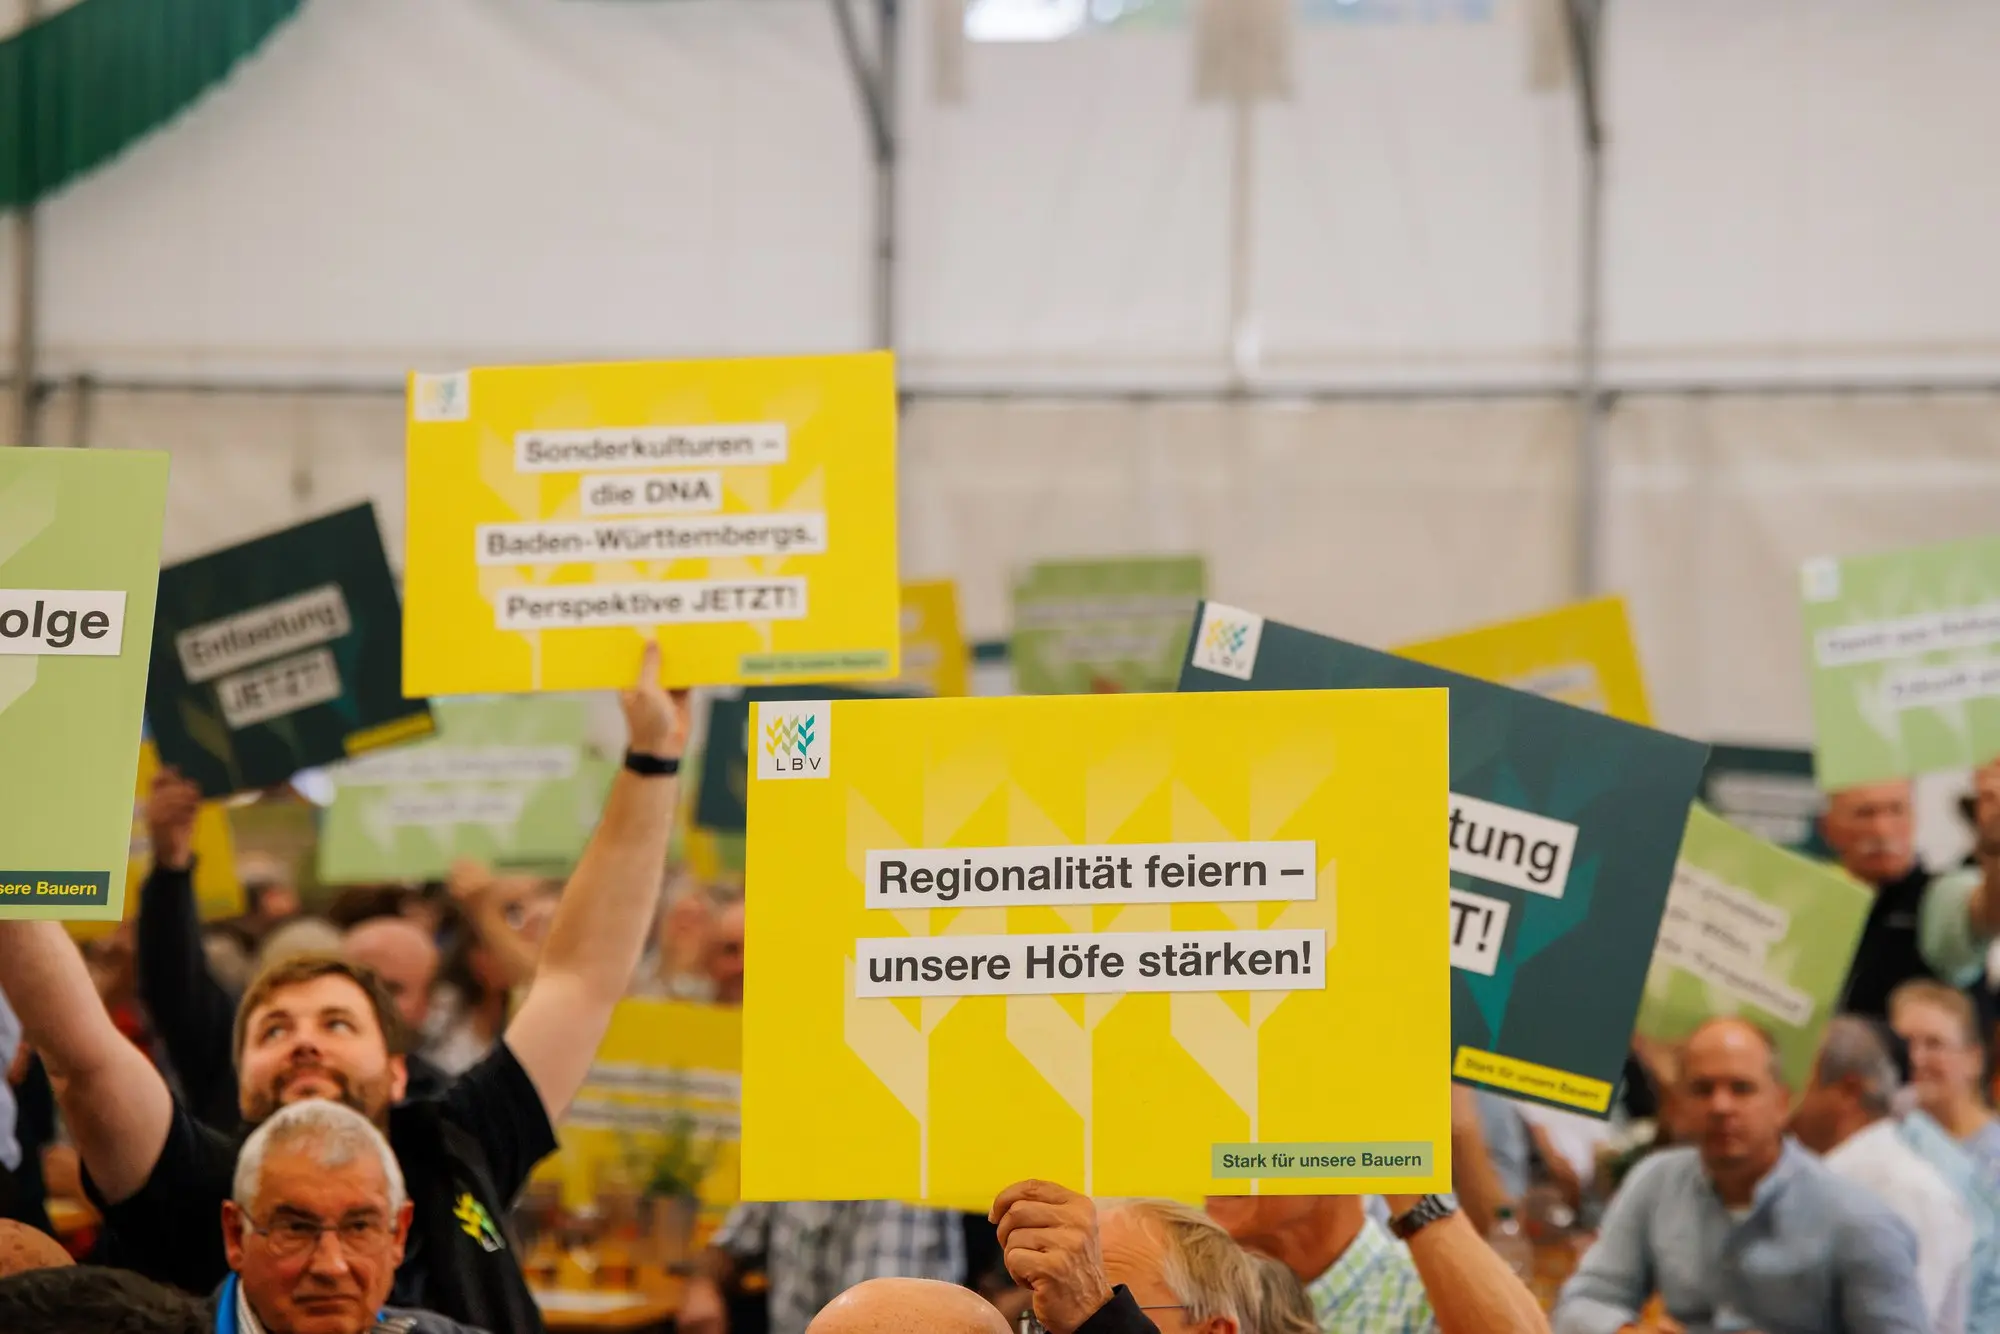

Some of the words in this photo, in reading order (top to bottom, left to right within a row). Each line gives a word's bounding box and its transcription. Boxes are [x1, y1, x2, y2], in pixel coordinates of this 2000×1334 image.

[525, 436, 754, 463] Sonderkulturen
[590, 483, 635, 505] die
[645, 479, 712, 503] DNA
[486, 523, 818, 556] Baden-Württembergs.
[507, 594, 682, 623] Perspektive
[694, 585, 798, 612] JETZT!
[0, 600, 110, 648] olge
[36, 881, 97, 896] Bauern
[879, 856, 1133, 901] Regionalität
[1144, 853, 1267, 888] feiern
[869, 954, 1011, 983] unsere
[1026, 944, 1125, 980] Höfe
[1138, 940, 1312, 978] stärken!
[1222, 1154, 1267, 1168] Stark
[1271, 1153, 1296, 1168] für
[1299, 1154, 1357, 1168] unsere
[1361, 1152, 1422, 1167] Bauern
